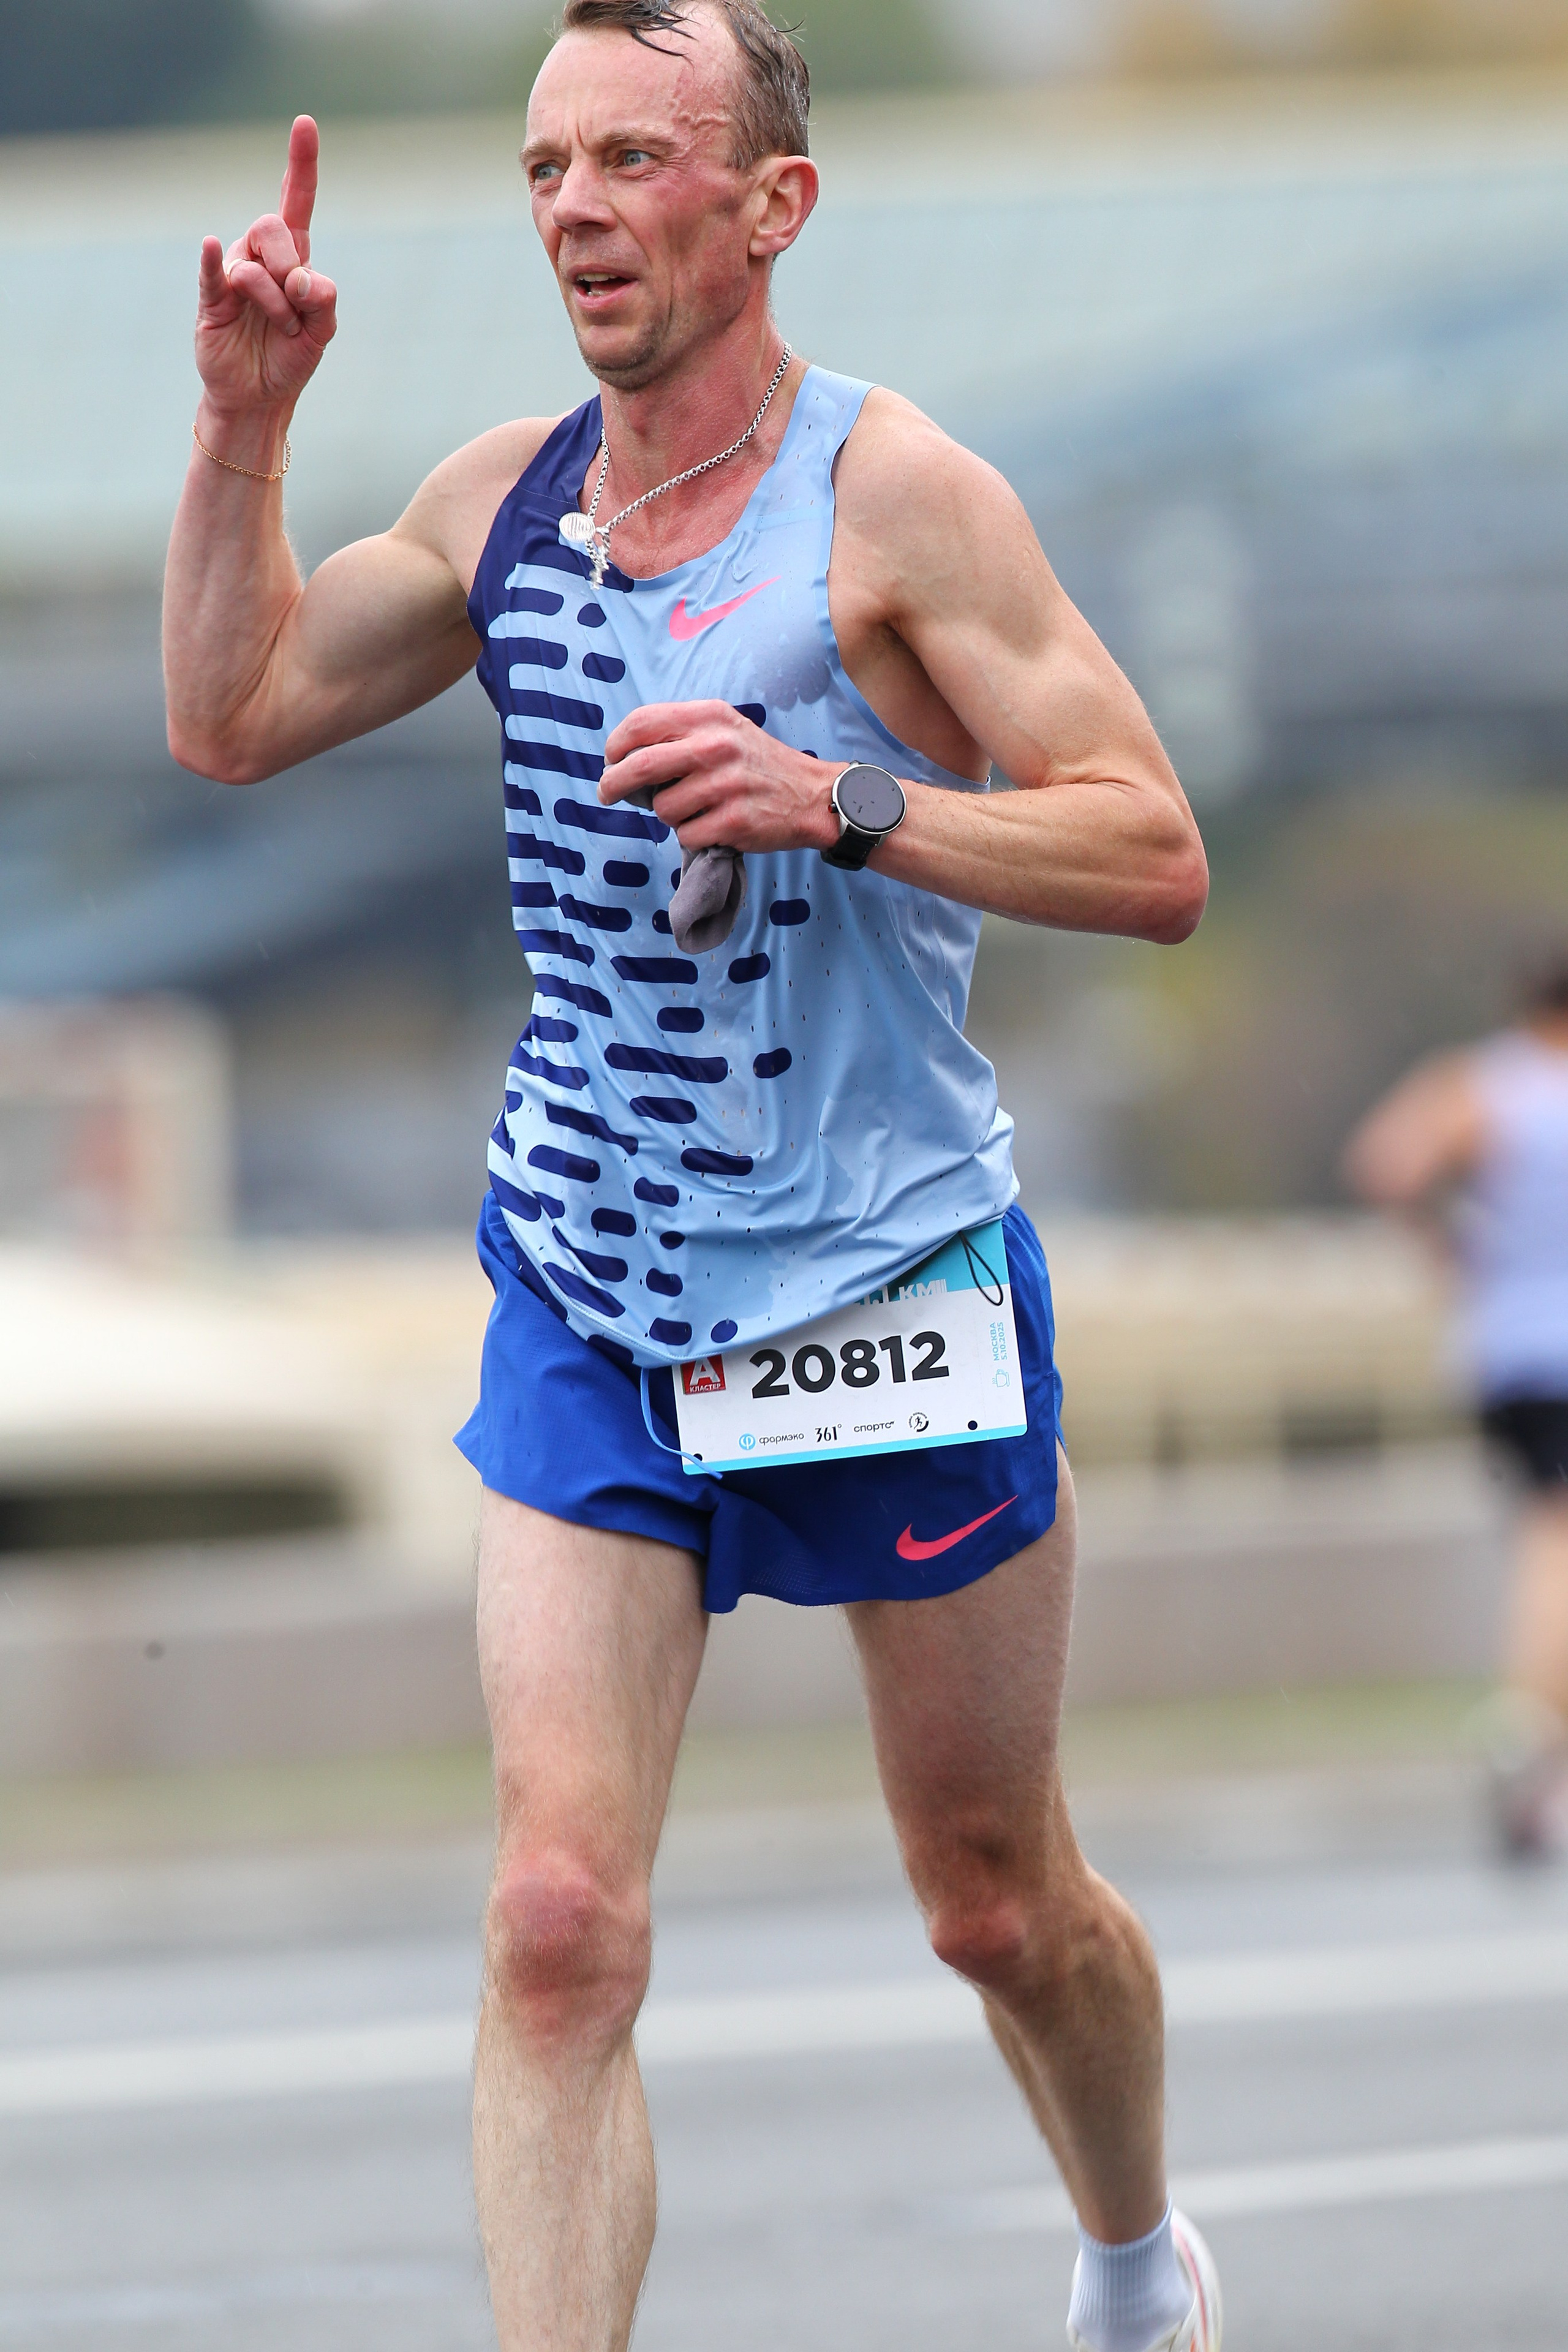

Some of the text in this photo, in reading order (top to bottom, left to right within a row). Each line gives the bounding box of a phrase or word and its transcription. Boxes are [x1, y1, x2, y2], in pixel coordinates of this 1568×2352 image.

[990, 1322, 1000, 1361] МОСКВА
[997, 1322, 1008, 1360] 5.10.2025
[749, 1331, 949, 1398] 20812
[690, 1383, 721, 1393] КЛАСТЕР
[759, 1433, 804, 1446] фармэко
